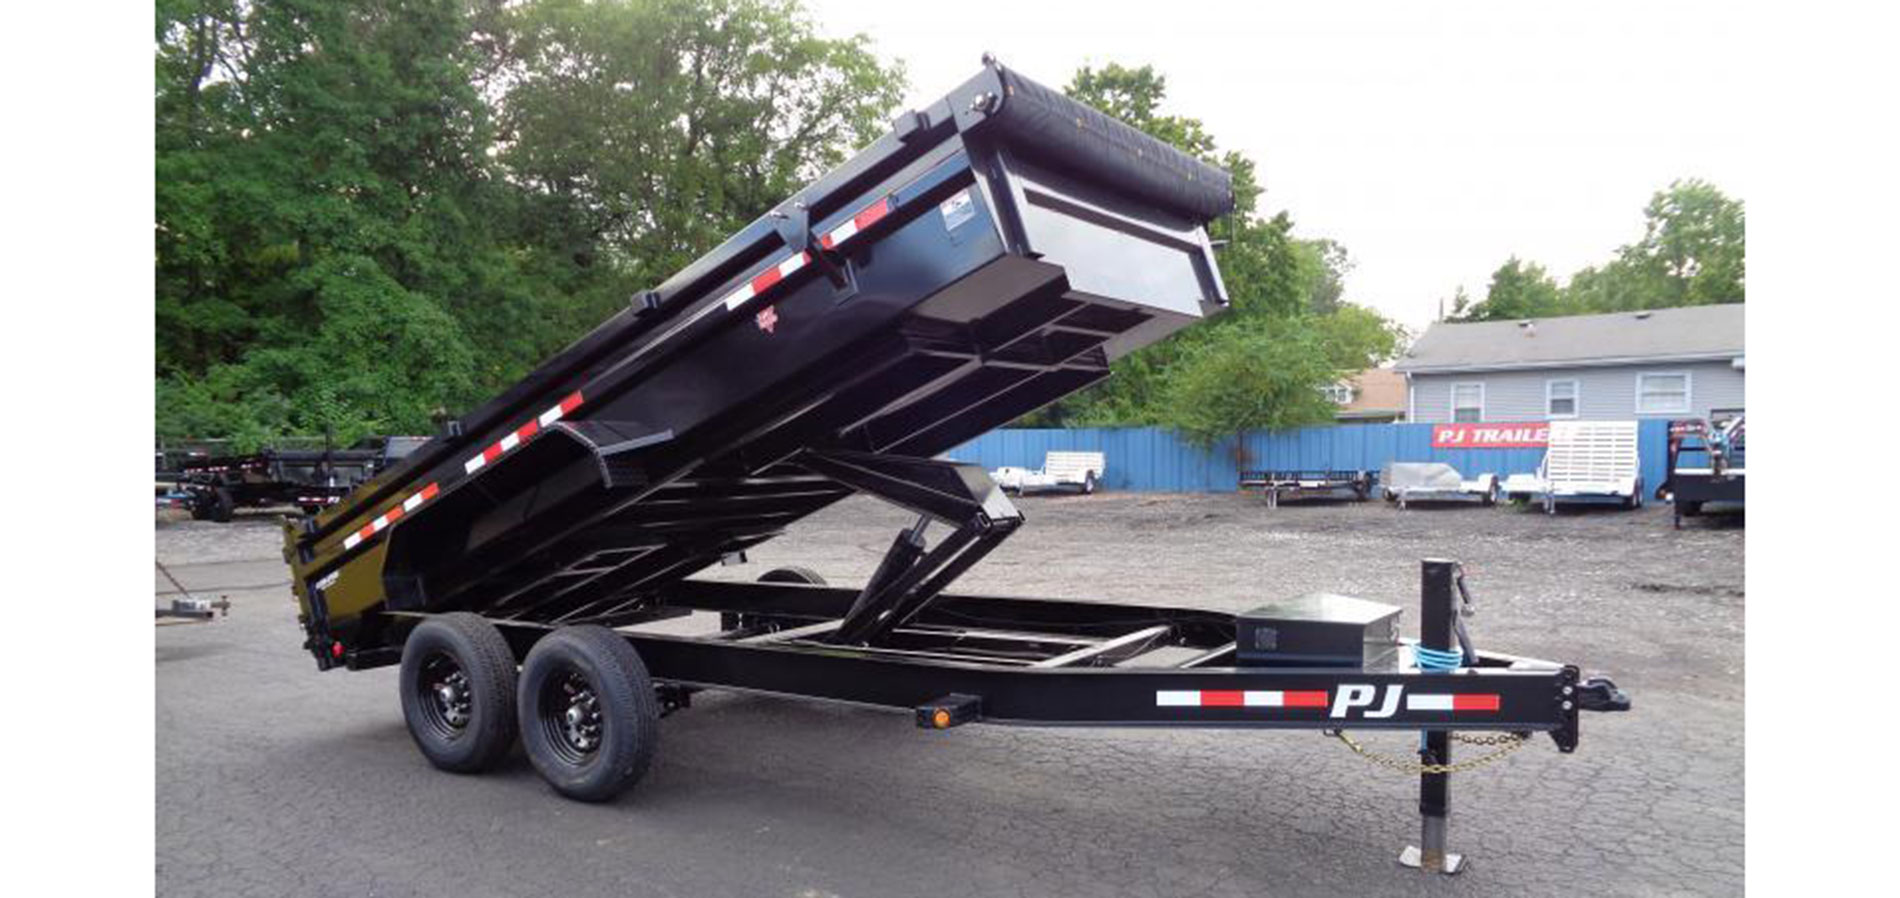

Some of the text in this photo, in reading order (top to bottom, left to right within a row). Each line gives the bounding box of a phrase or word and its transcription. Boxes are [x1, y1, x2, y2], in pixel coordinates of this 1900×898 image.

[1437, 429, 1549, 443] PJ TRAILE
[1329, 684, 1404, 718] PJ
